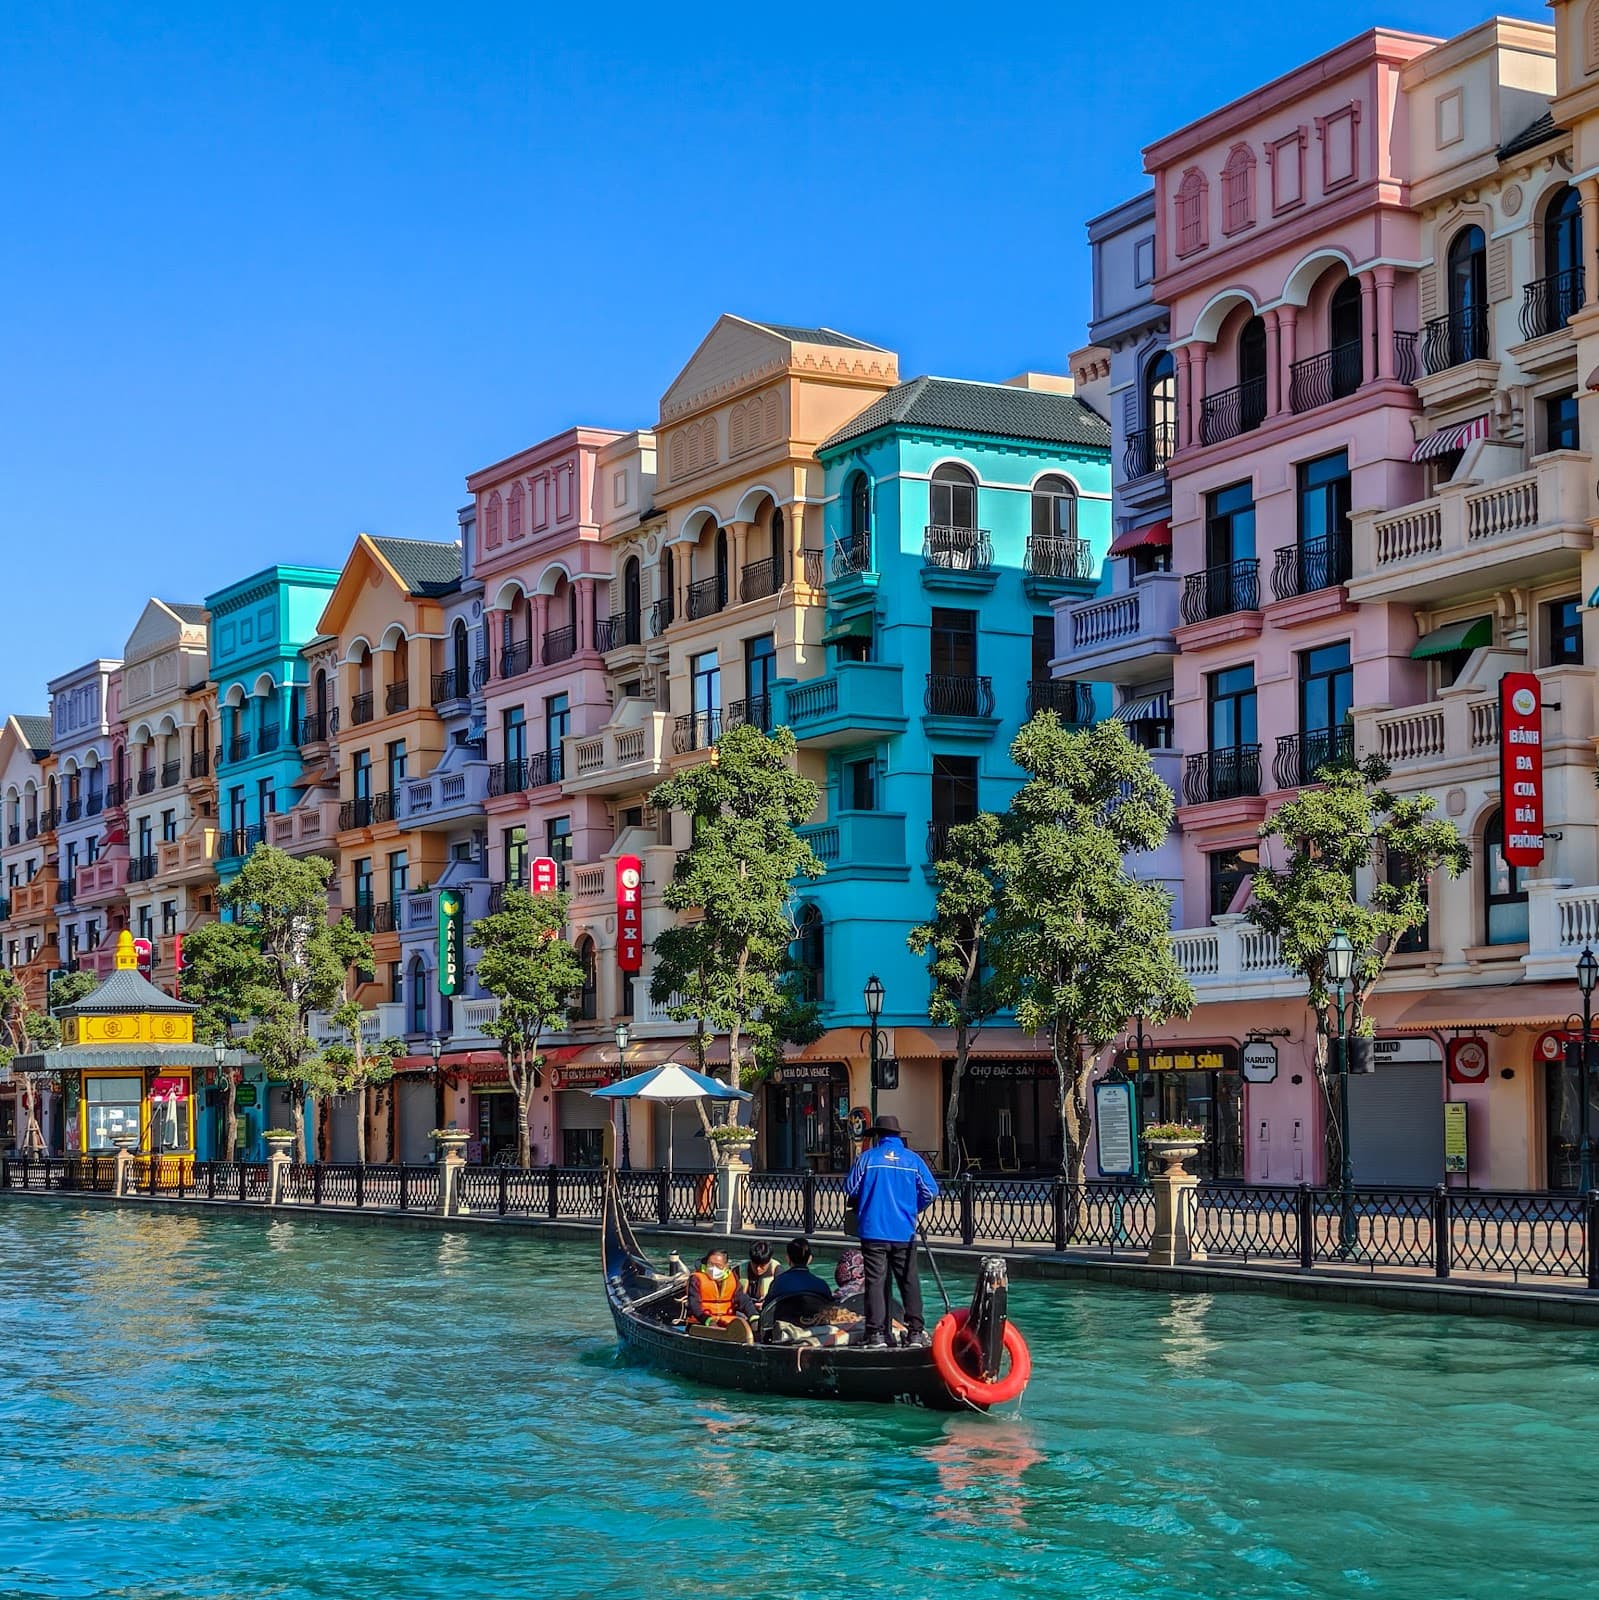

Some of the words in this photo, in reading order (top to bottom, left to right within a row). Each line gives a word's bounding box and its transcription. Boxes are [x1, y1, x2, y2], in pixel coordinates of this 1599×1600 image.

[1509, 726, 1539, 744] BÁNH
[1516, 756, 1533, 770] ĐA
[1513, 782, 1536, 796] CUA
[447, 919, 456, 985] ANANDA
[1245, 1056, 1275, 1064] NARUTO
[970, 1066, 991, 1078] CHỢ
[993, 1063, 1012, 1078] ĐẶC
